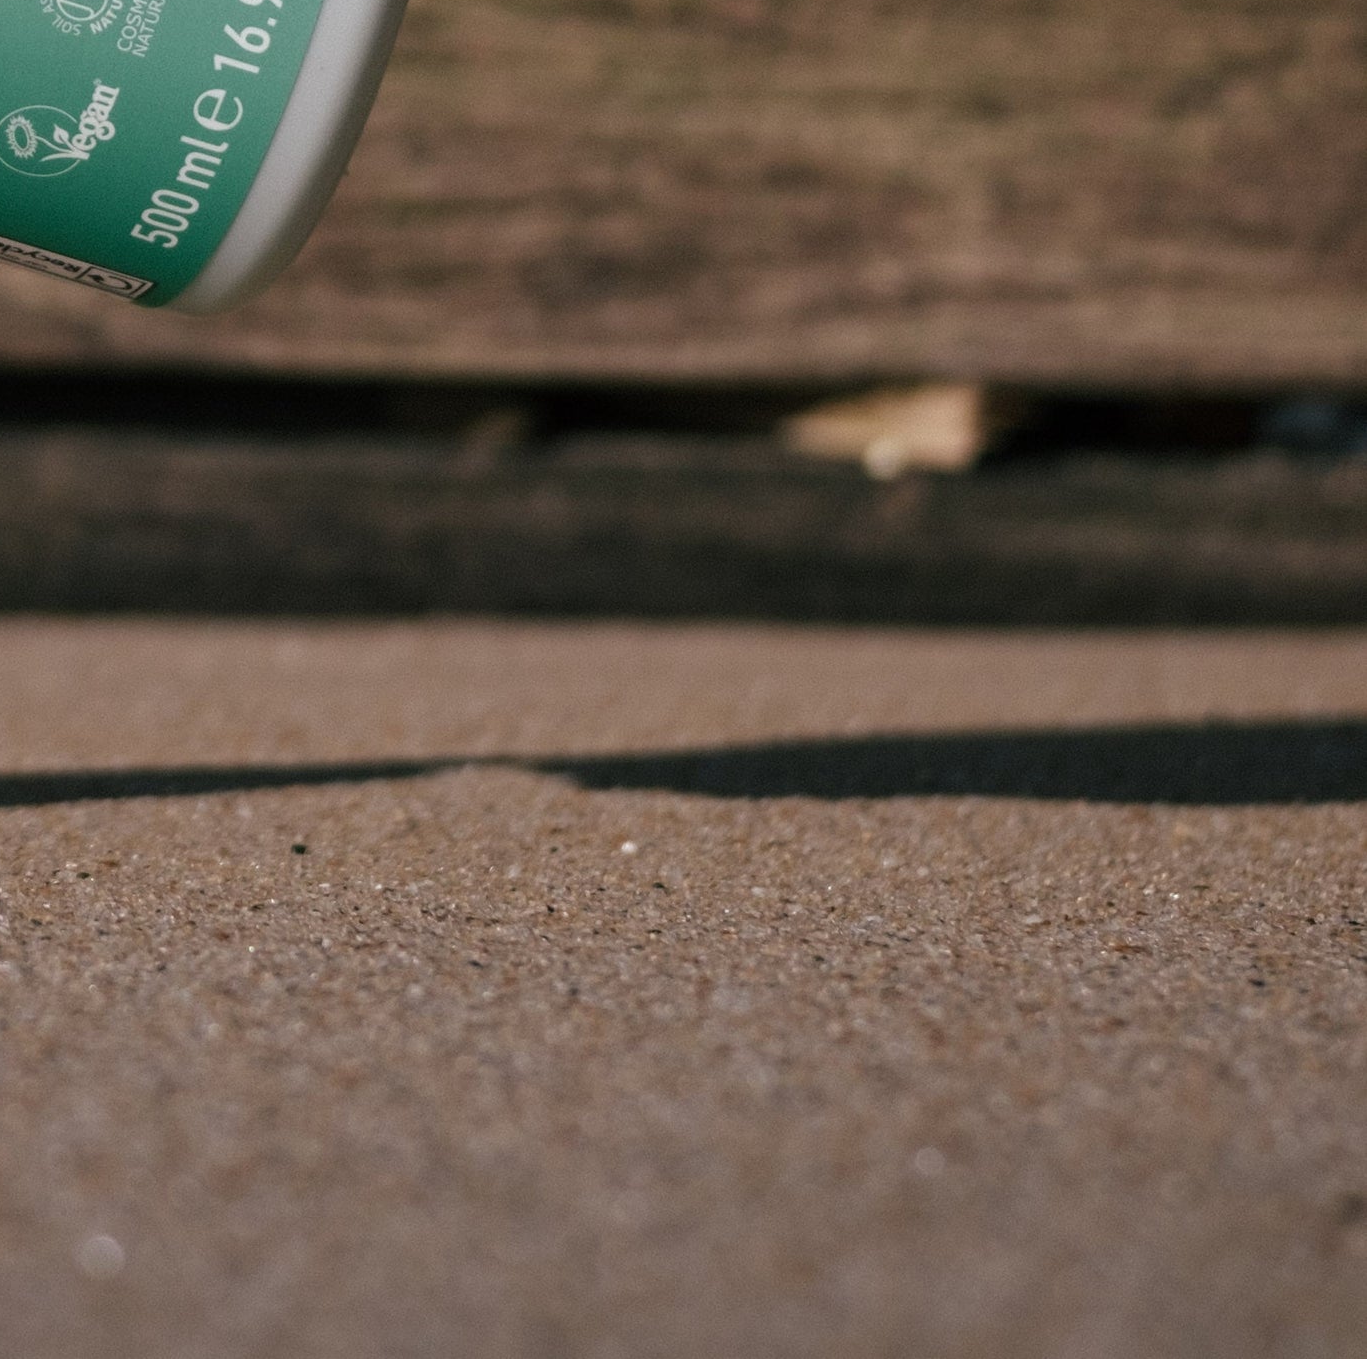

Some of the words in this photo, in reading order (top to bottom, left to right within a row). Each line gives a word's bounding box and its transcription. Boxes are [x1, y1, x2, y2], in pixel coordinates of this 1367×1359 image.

[53, 13, 81, 37] SOIL
[55, 83, 121, 161] Vegan
[130, 188, 200, 250] 500
[177, 135, 229, 190] ml
